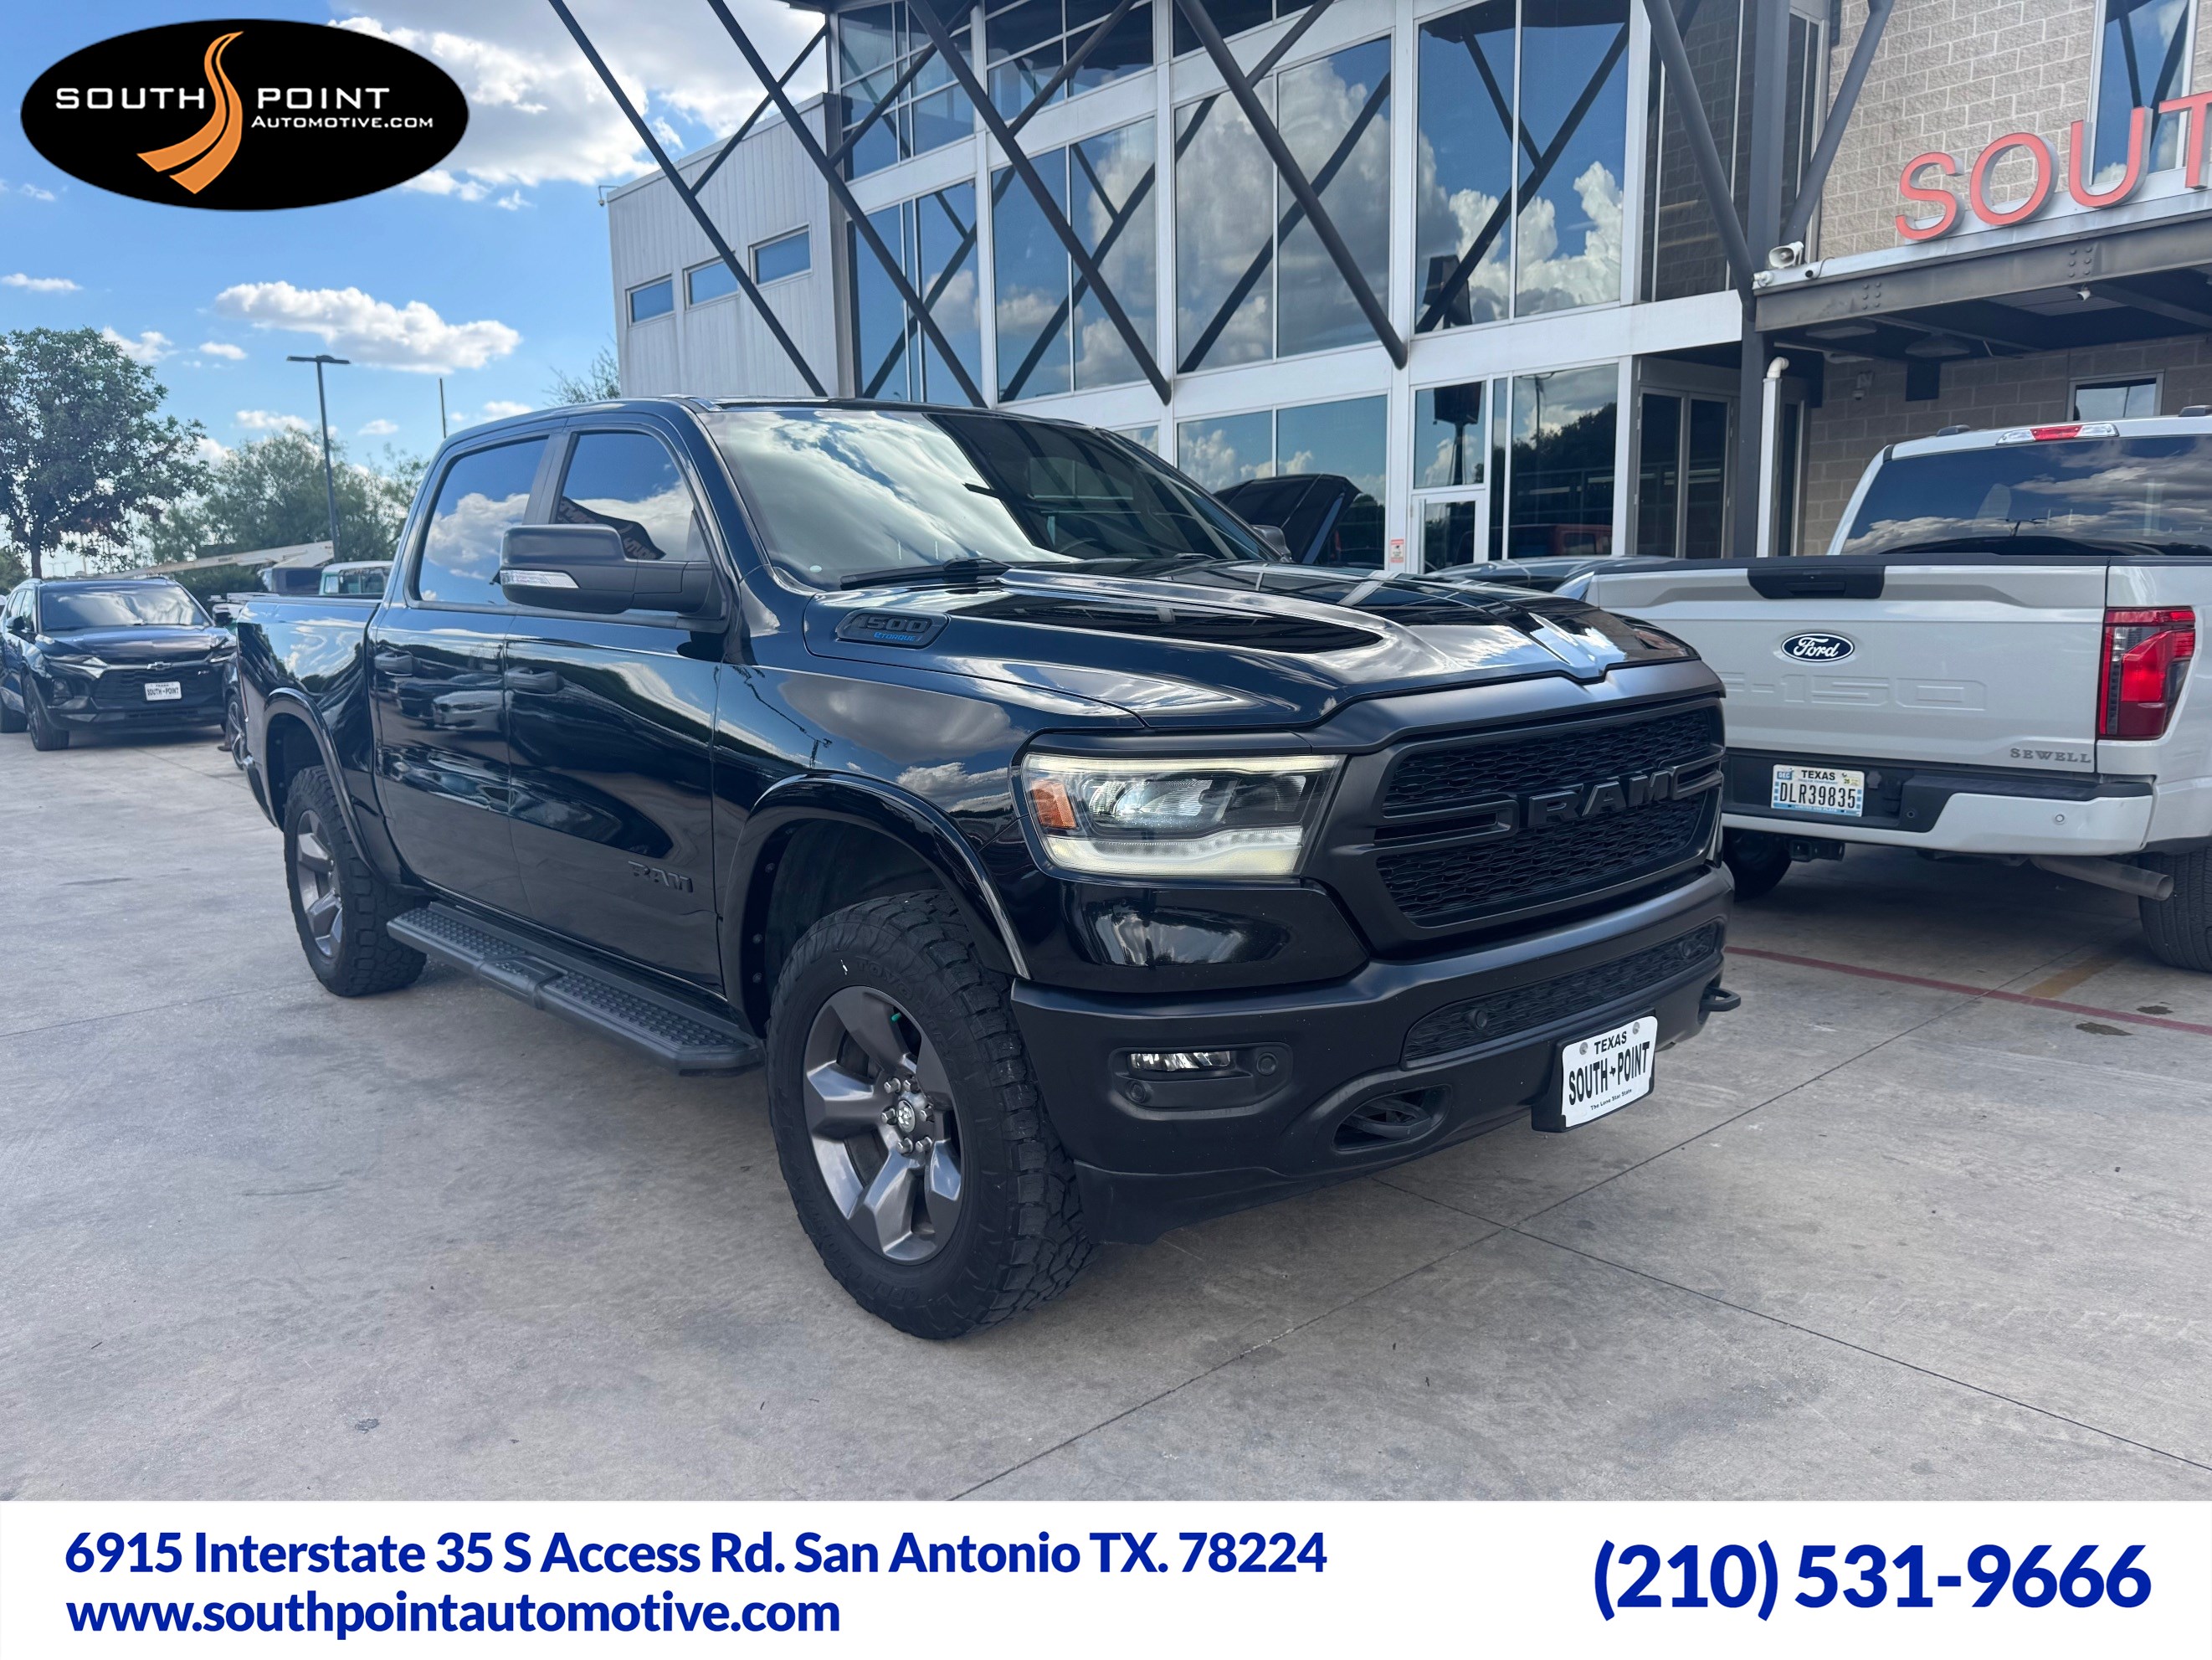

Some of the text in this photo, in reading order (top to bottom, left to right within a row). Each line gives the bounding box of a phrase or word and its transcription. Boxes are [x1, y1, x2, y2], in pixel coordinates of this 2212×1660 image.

[849, 614, 929, 633] 1500
[1793, 636, 1840, 658] Ford
[2009, 748, 2091, 763] SEWELL
[1801, 769, 1835, 781] TEXAS
[1528, 769, 1671, 829] RAM
[1779, 782, 1857, 809] DLR39835
[628, 860, 694, 893] RAM
[1594, 1030, 1627, 1055] TEXAS
[1568, 1041, 1650, 1106] SOUTH POINT
[1599, 1097, 1611, 1107] Lone
[1621, 1088, 1632, 1097] State
